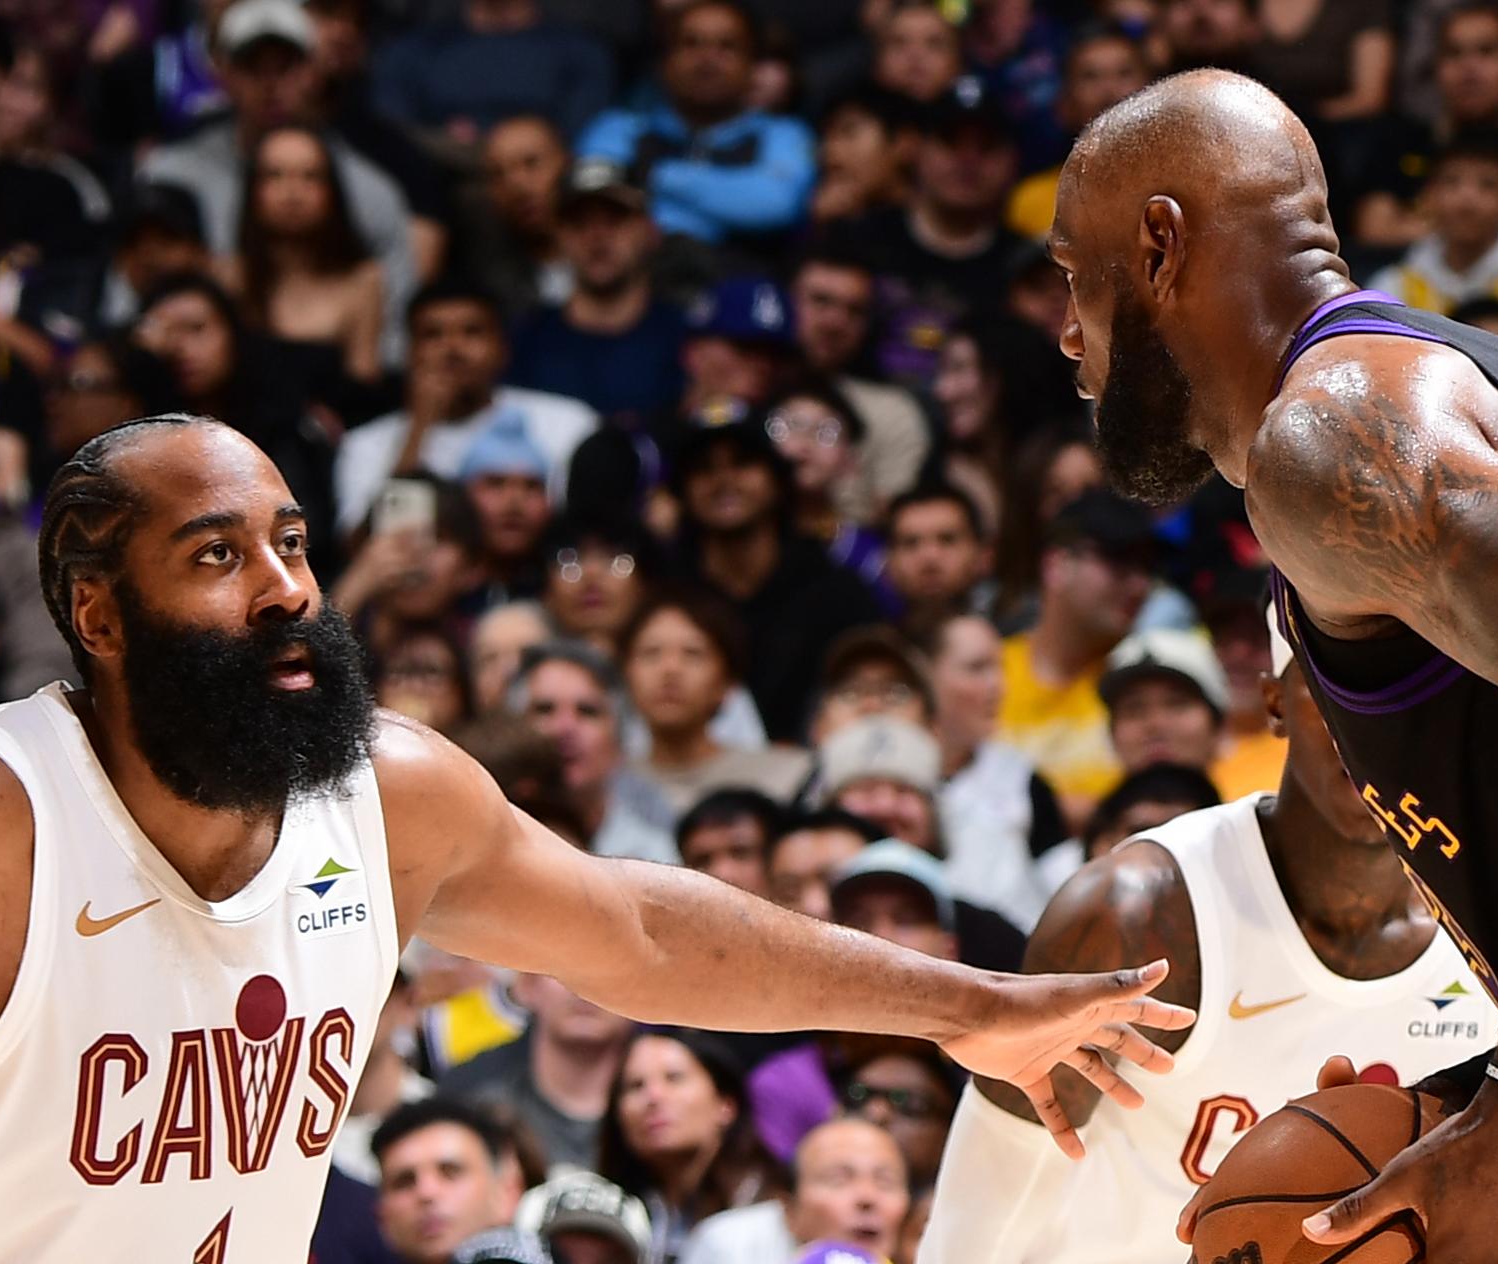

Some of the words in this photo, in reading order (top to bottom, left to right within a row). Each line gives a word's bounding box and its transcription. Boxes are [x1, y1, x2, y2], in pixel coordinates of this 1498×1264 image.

[297, 903, 367, 933] CLIFFS
[1407, 1021, 1479, 1038] CLIFFS
[69, 1006, 355, 1186] CAVS
